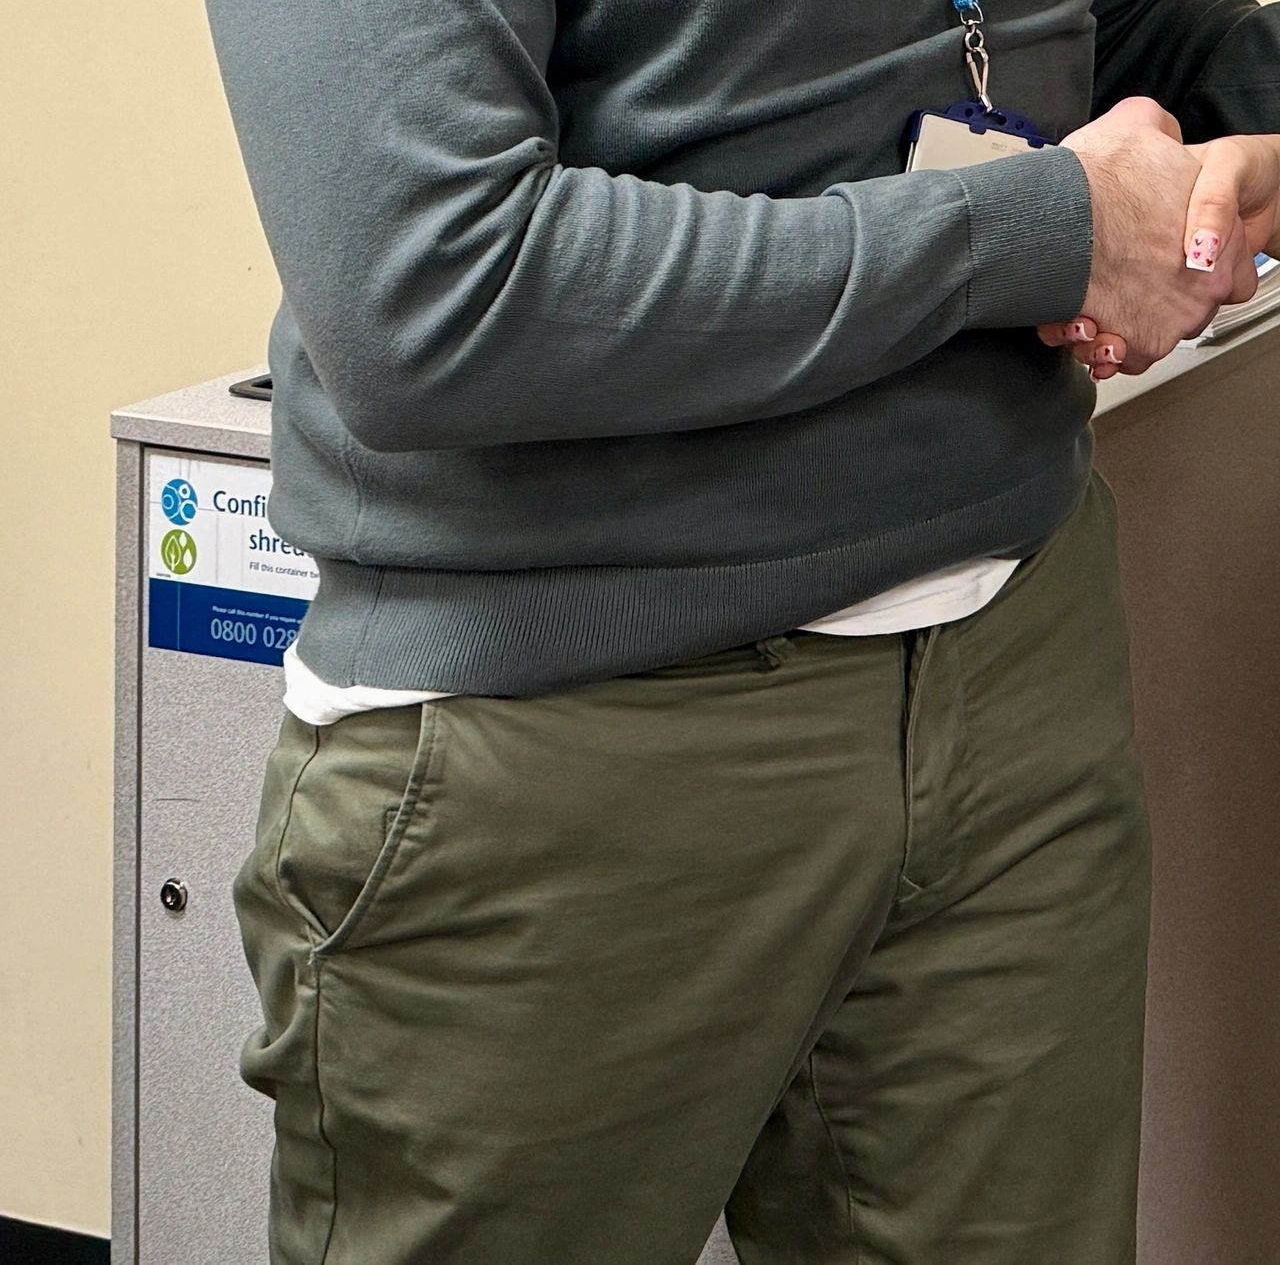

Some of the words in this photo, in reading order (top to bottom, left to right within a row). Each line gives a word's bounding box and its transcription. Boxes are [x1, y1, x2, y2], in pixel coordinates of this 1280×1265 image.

[213, 490, 266, 518] Confi
[249, 561, 260, 570] Fill
[261, 564, 274, 573] this
[275, 566, 308, 578] container
[211, 618, 257, 645] 0800
